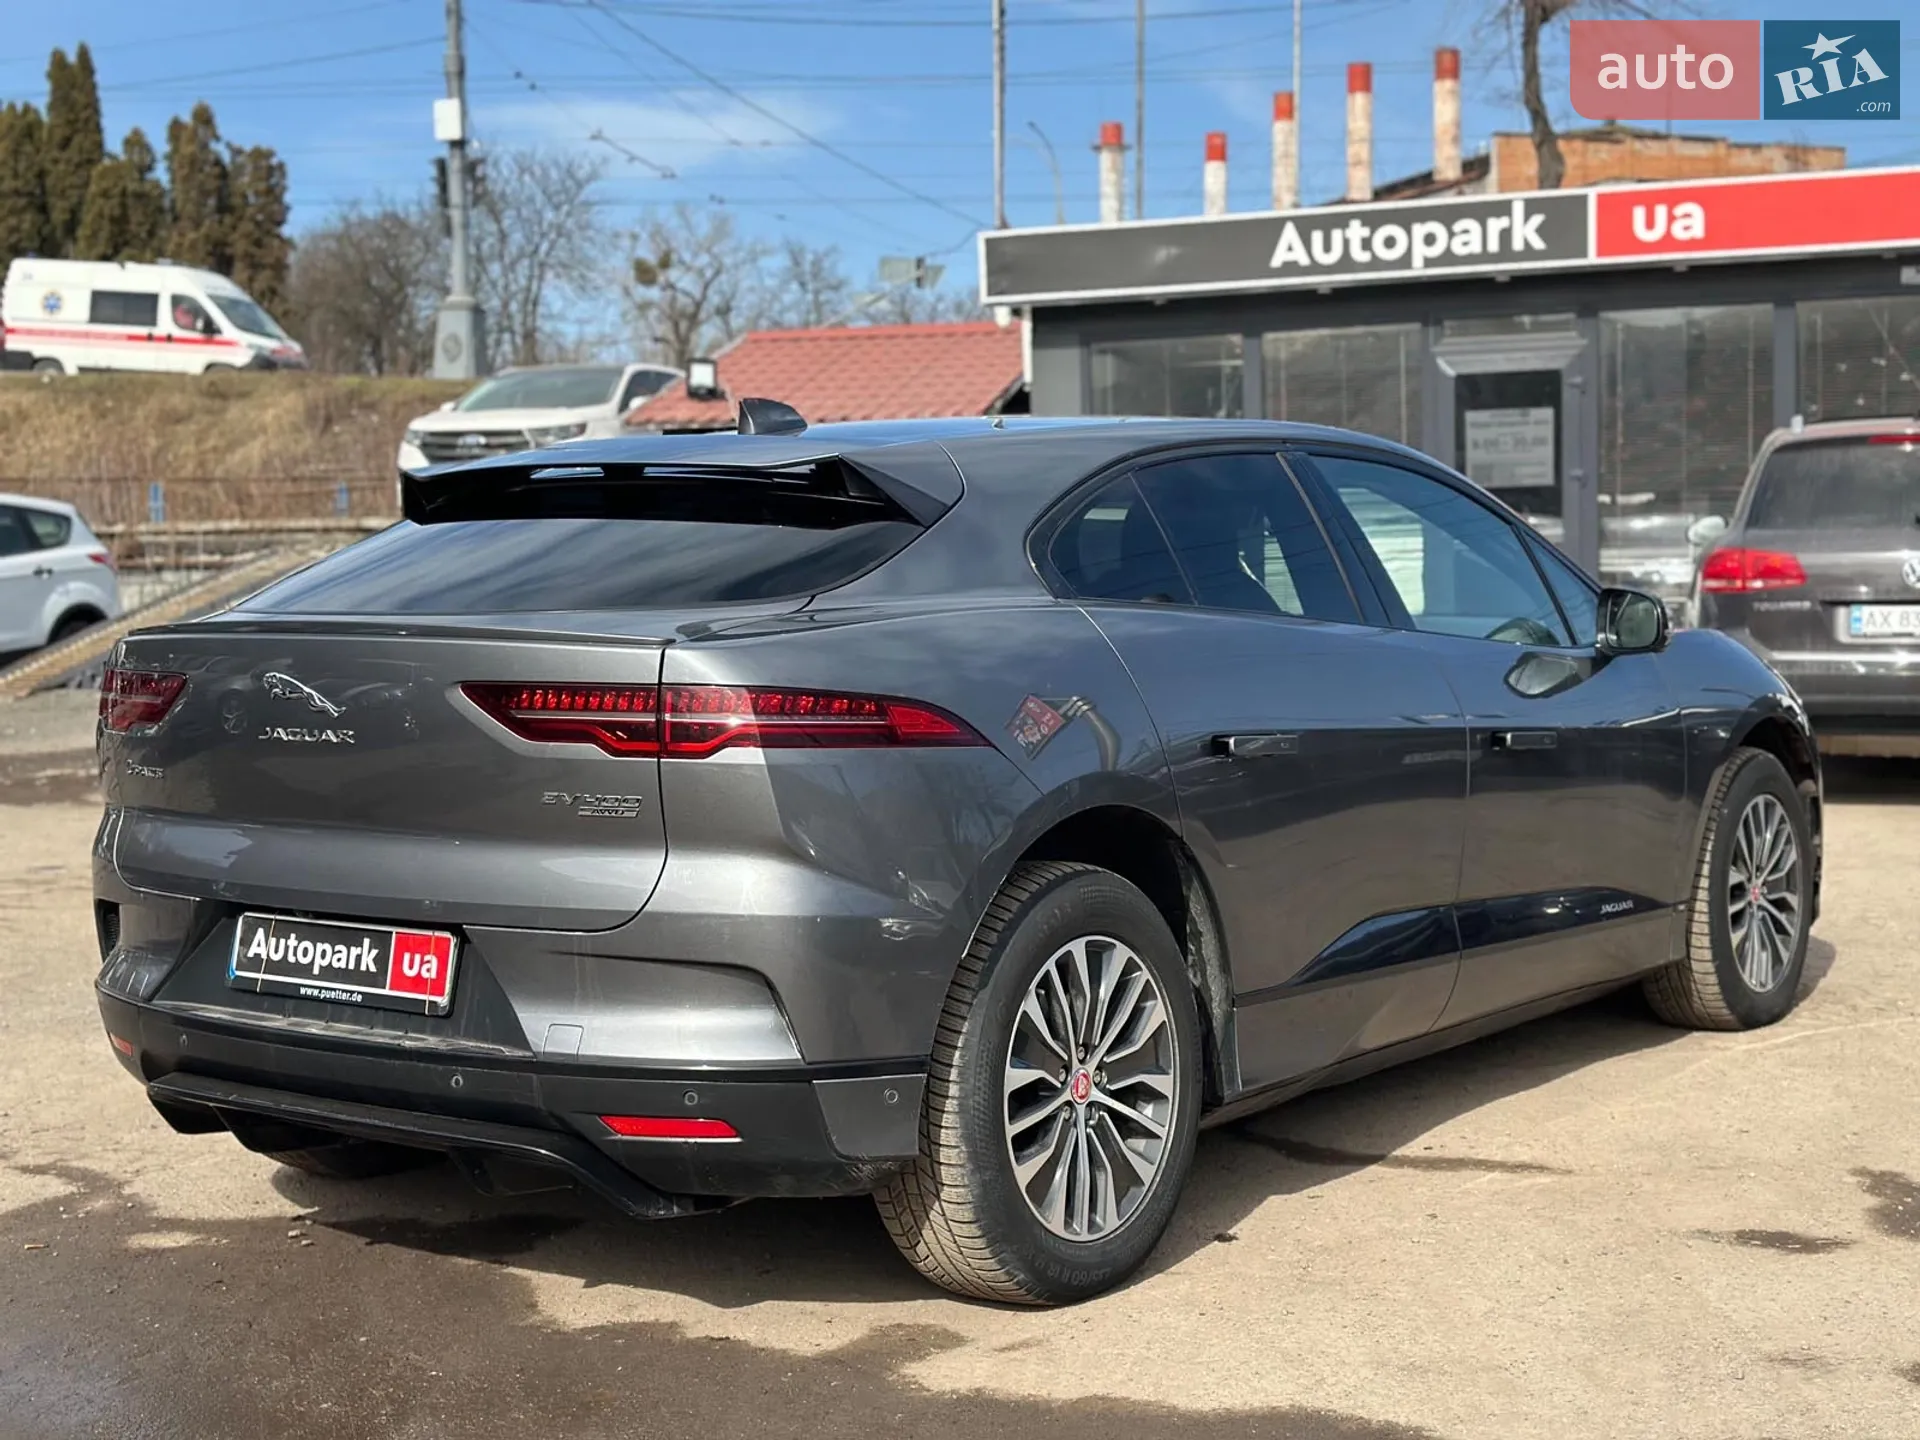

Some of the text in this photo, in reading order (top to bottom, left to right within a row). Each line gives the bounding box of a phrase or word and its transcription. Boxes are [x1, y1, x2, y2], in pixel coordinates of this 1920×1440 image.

[1269, 198, 1706, 269] Autopark ua
[258, 727, 356, 744] JAGUAR
[590, 807, 626, 817] AWD
[247, 926, 439, 980] Autopark ua
[299, 986, 363, 1003] www.puetter.de
